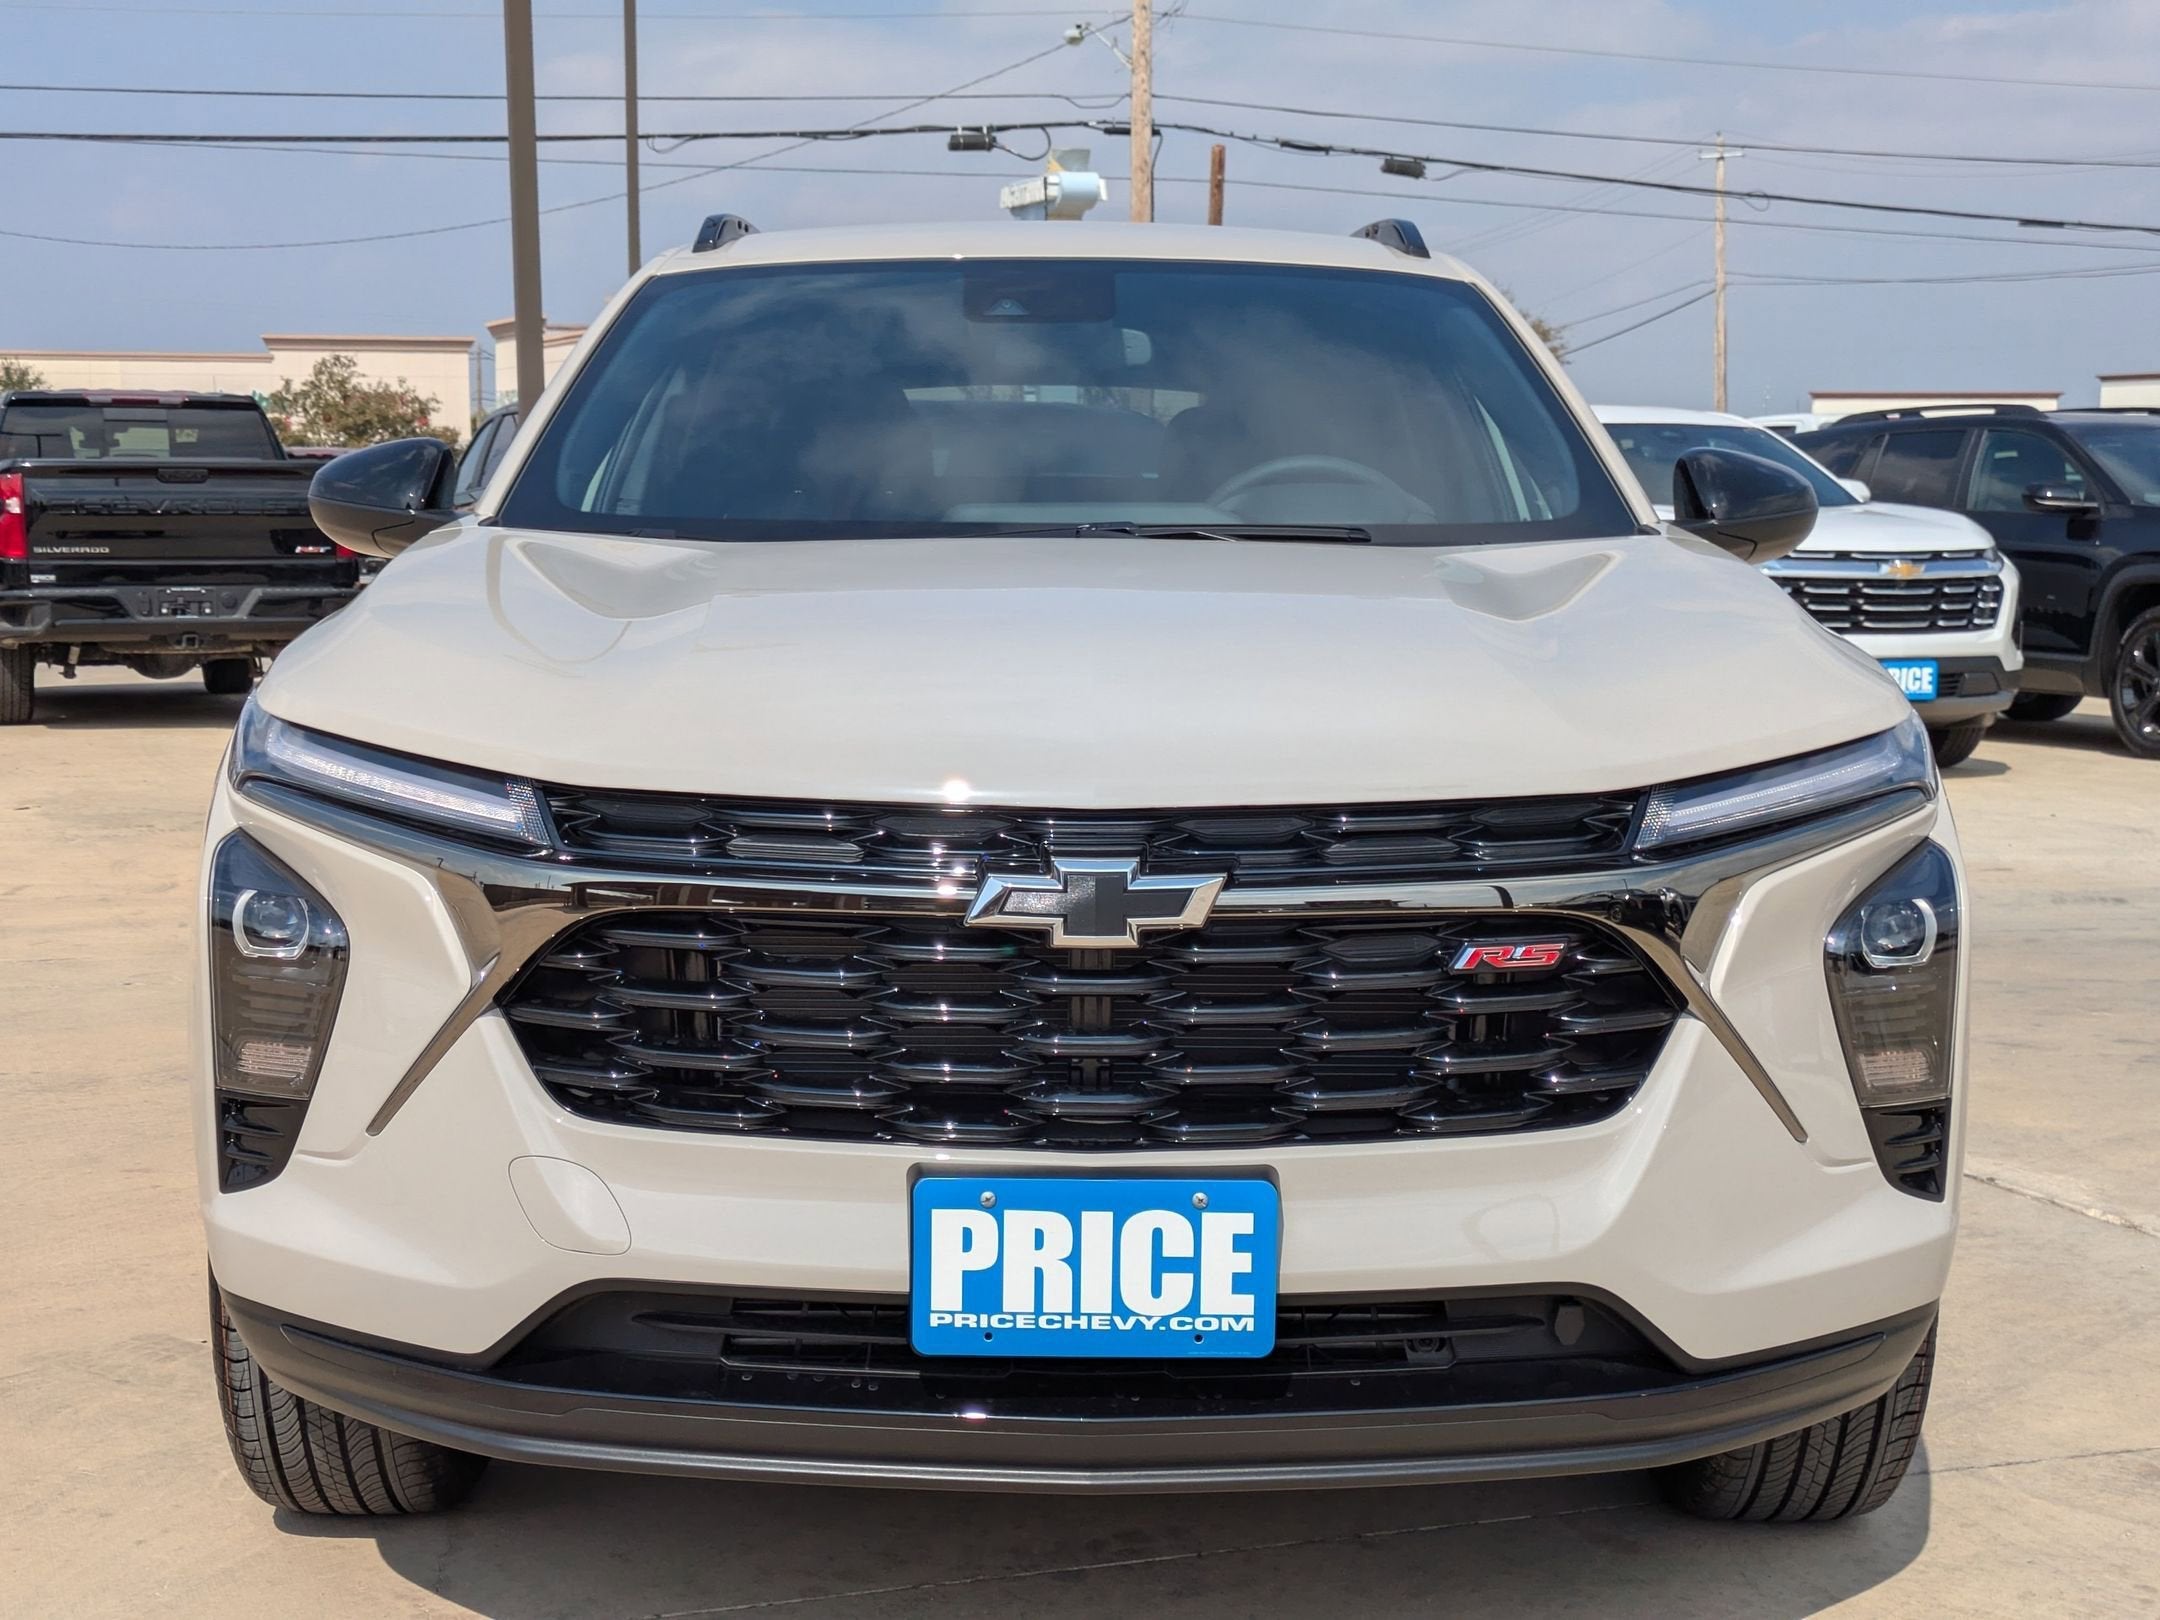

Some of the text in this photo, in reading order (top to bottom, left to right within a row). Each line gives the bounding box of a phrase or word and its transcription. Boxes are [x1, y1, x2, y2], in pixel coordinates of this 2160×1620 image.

[1454, 943, 1565, 970] RS
[931, 1210, 1254, 1316] PRICE
[930, 1313, 1254, 1332] PRICECHEVY.COM
